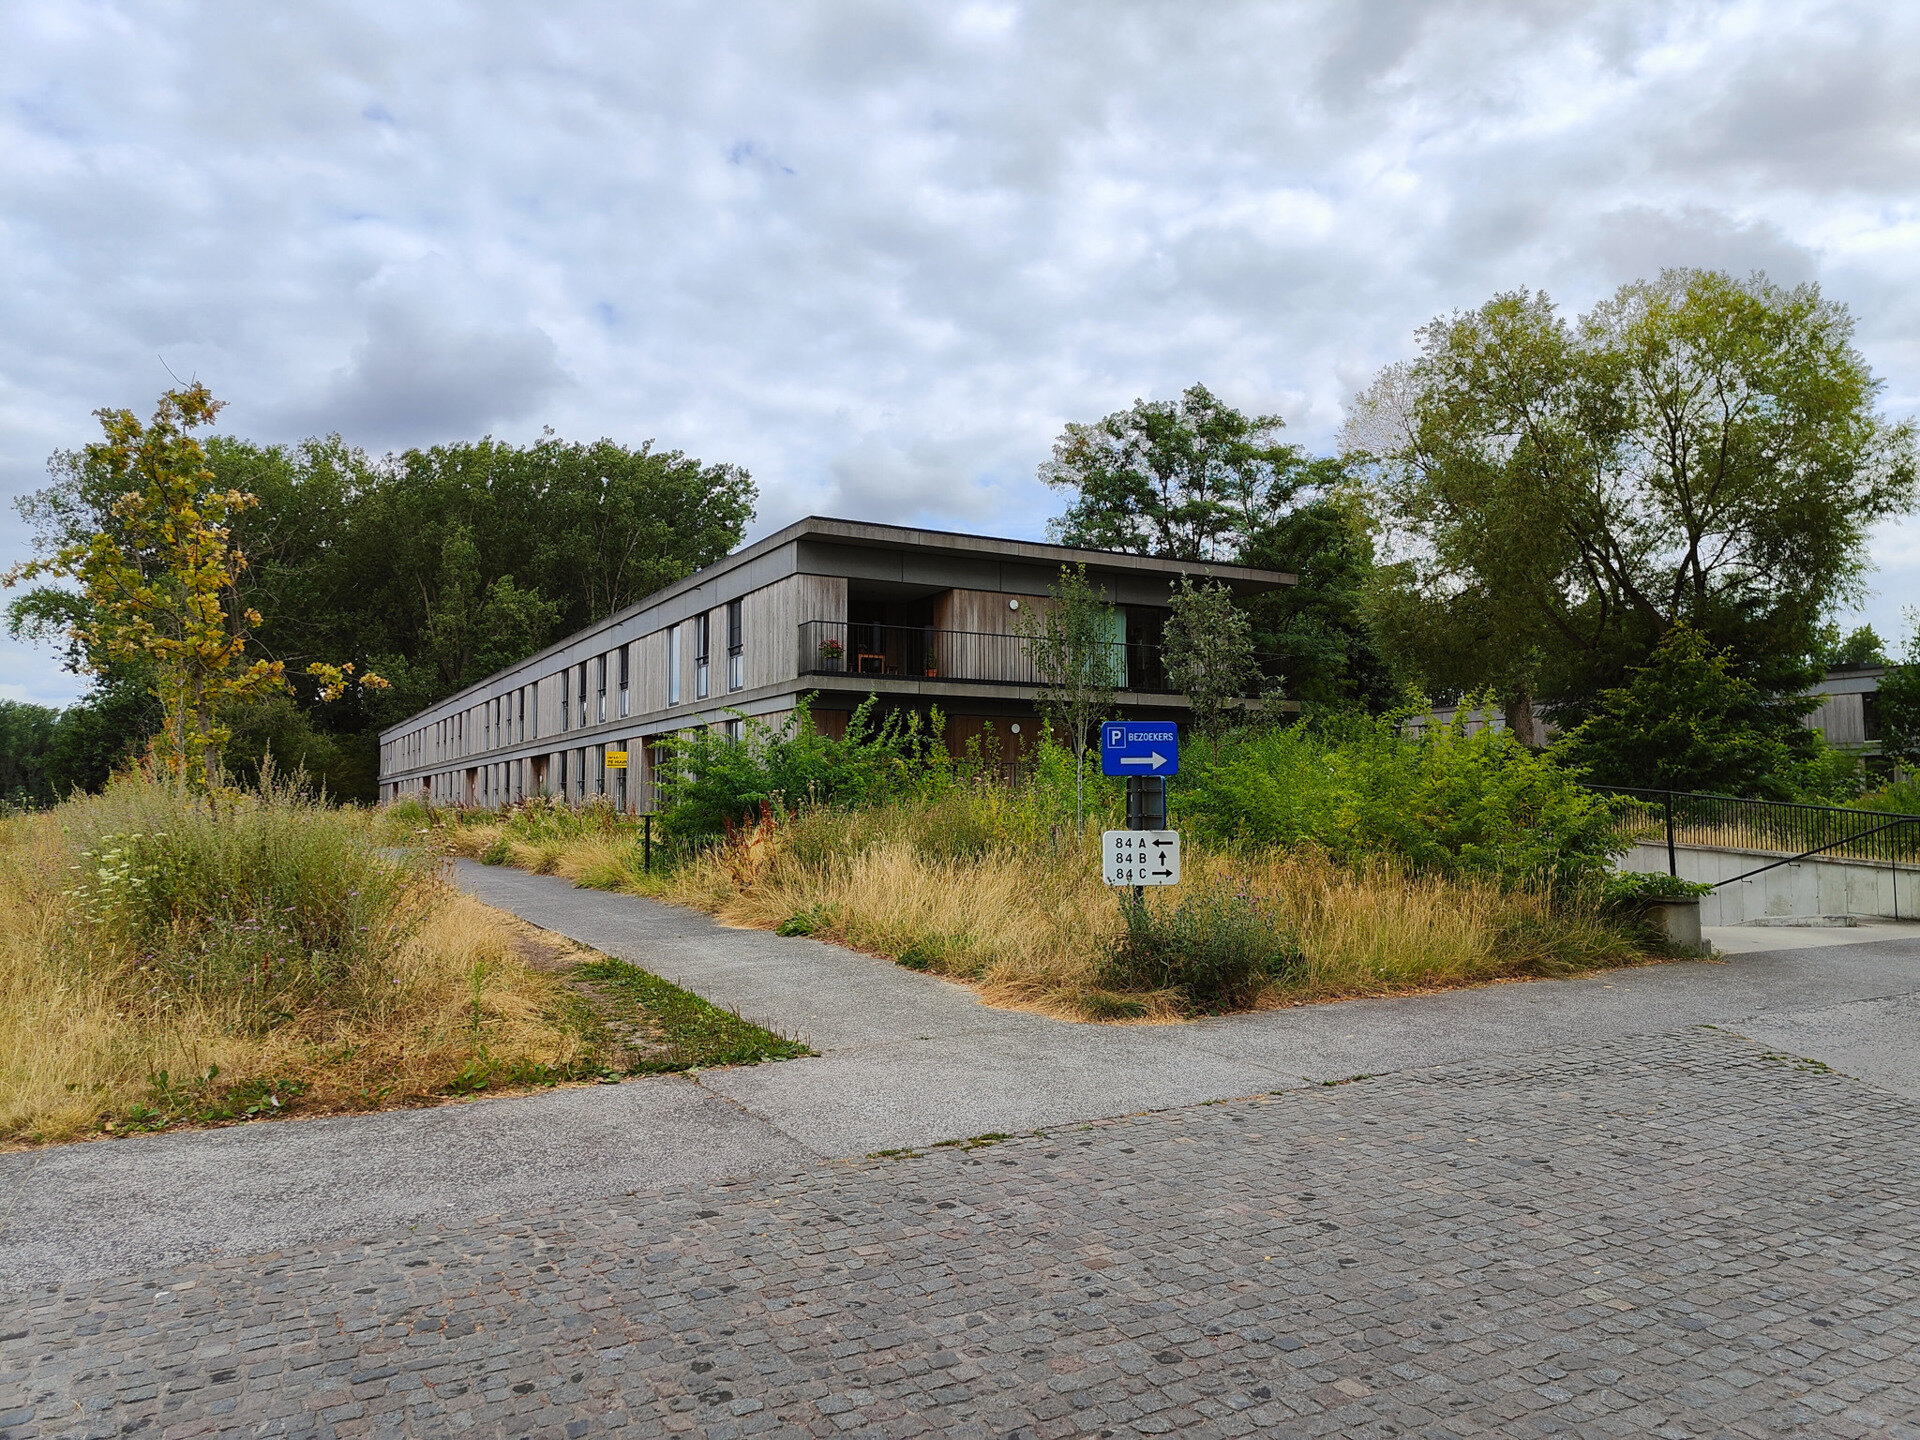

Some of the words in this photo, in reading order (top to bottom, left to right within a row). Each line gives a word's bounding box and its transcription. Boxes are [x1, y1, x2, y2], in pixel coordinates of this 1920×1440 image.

[1112, 730, 1121, 745] P
[1128, 732, 1174, 742] BEZOEKERS
[1115, 837, 1132, 849] 84
[1138, 837, 1147, 849] A
[1115, 852, 1133, 864] 84
[1139, 852, 1147, 864] B
[1116, 868, 1133, 879] 84
[1139, 868, 1147, 879] C
